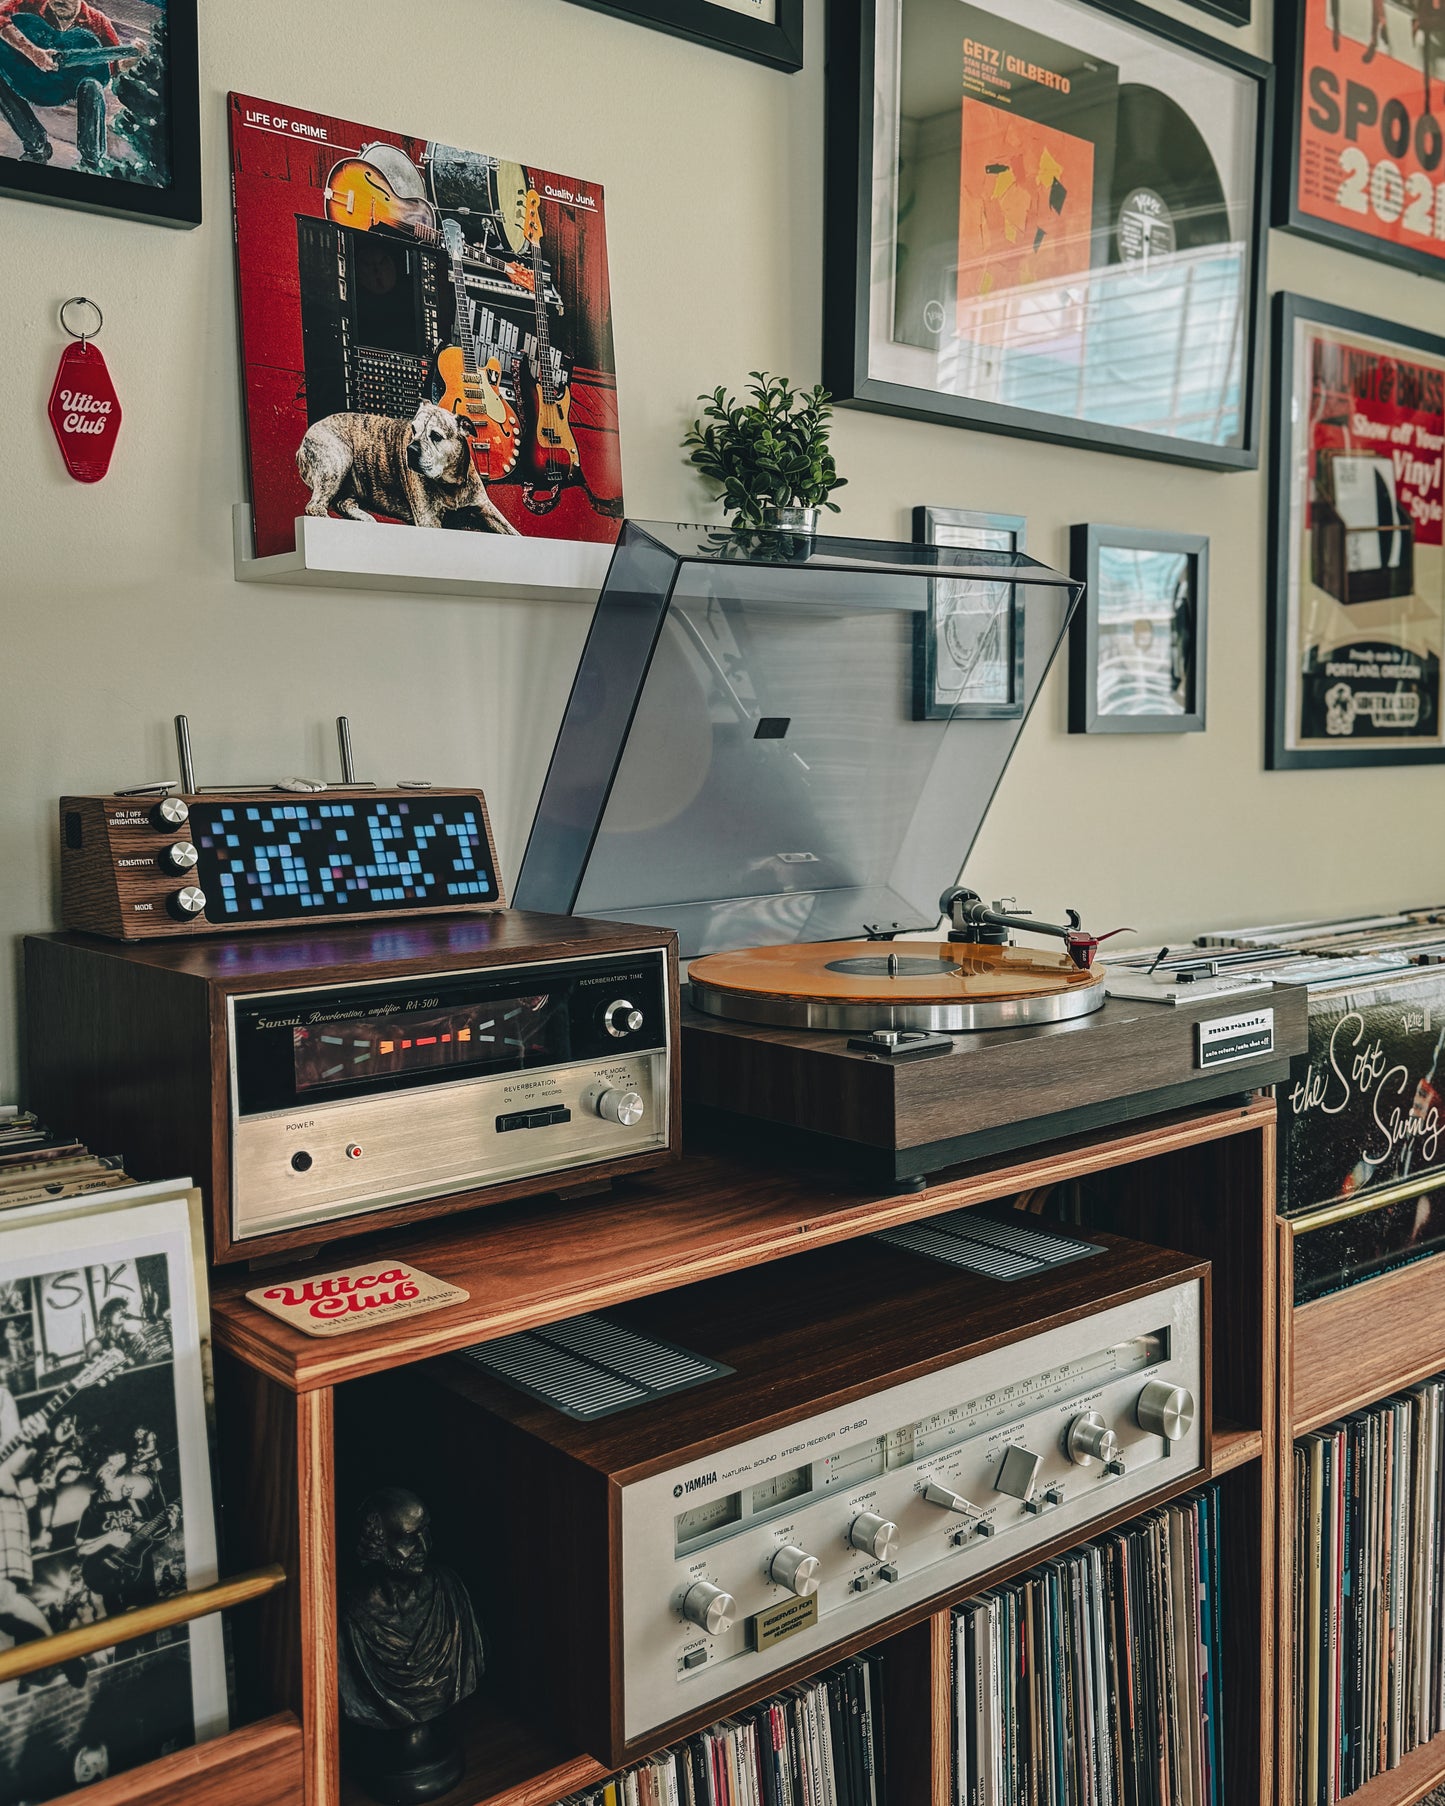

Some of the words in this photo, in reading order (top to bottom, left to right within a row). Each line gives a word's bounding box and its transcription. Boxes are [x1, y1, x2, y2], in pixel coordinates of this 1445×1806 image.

[981, 63, 998, 76] GETZ
[982, 71, 1011, 90] GILBERTO
[246, 110, 271, 126] LIFE
[273, 117, 288, 129] OF
[291, 121, 328, 139] GRIME
[545, 185, 574, 203] Quality
[575, 193, 596, 207] Junk
[60, 389, 112, 414] Utica
[63, 412, 107, 435] Club
[1353, 413, 1391, 441] Show
[1391, 421, 1414, 446] off
[1415, 425, 1445, 450] Your
[1392, 449, 1442, 496] Vinyl
[1410, 496, 1442, 525] Style
[118, 858, 154, 866] SENSITIVITY
[579, 975, 628, 986] REVERBERATION
[256, 1015, 302, 1030] Sansui
[306, 1009, 366, 1025] Reverberation
[368, 1004, 400, 1017] amplifier
[406, 998, 438, 1010] RA-500
[1208, 1018, 1266, 1034] marantz
[1249, 1040, 1260, 1048] shut
[1261, 1037, 1269, 1045] off
[594, 1069, 607, 1077] TAPE
[610, 1066, 627, 1075] MODE
[1289, 1065, 1328, 1114] the
[1321, 1012, 1386, 1114] Soft
[504, 1079, 556, 1093] REVERBERATION
[1362, 1065, 1445, 1165] Swing
[286, 1120, 315, 1131] POWER
[263, 1268, 411, 1306] Utica
[309, 1281, 420, 1319] Club
[322, 1313, 365, 1328] where
[378, 1301, 412, 1314] really
[1144, 1369, 1158, 1378] TUNING
[931, 1415, 940, 1423] 94
[985, 1394, 996, 1402] 100
[1004, 1387, 1014, 1395] 102
[1022, 1379, 1033, 1387] 104
[1060, 1403, 1077, 1413] VOLUME
[1084, 1391, 1103, 1403] BALANCE
[988, 1433, 1001, 1442] INPUT
[1002, 1423, 1025, 1436] SELECTOR
[684, 1472, 717, 1493] YAMAHA
[722, 1465, 752, 1479] NATURAL
[753, 1454, 777, 1467] SOUND
[781, 1443, 806, 1457] STEREO
[807, 1432, 836, 1448] RECEIVER
[831, 1455, 840, 1463] FM
[917, 1463, 927, 1471] REC
[928, 1459, 937, 1467] OUT
[938, 1449, 962, 1462] SELECTOR
[1044, 1480, 1057, 1488] MODE
[849, 1490, 877, 1505] LOUDNESS
[982, 1507, 997, 1517] FILTER
[774, 1525, 794, 1537] TREBLE
[944, 1526, 954, 1535] LOW
[955, 1519, 970, 1530] FILTER
[689, 1562, 707, 1573] BASS
[764, 1607, 798, 1628] RESERVED
[799, 1600, 813, 1610] FOR
[684, 1638, 707, 1652] POWER
